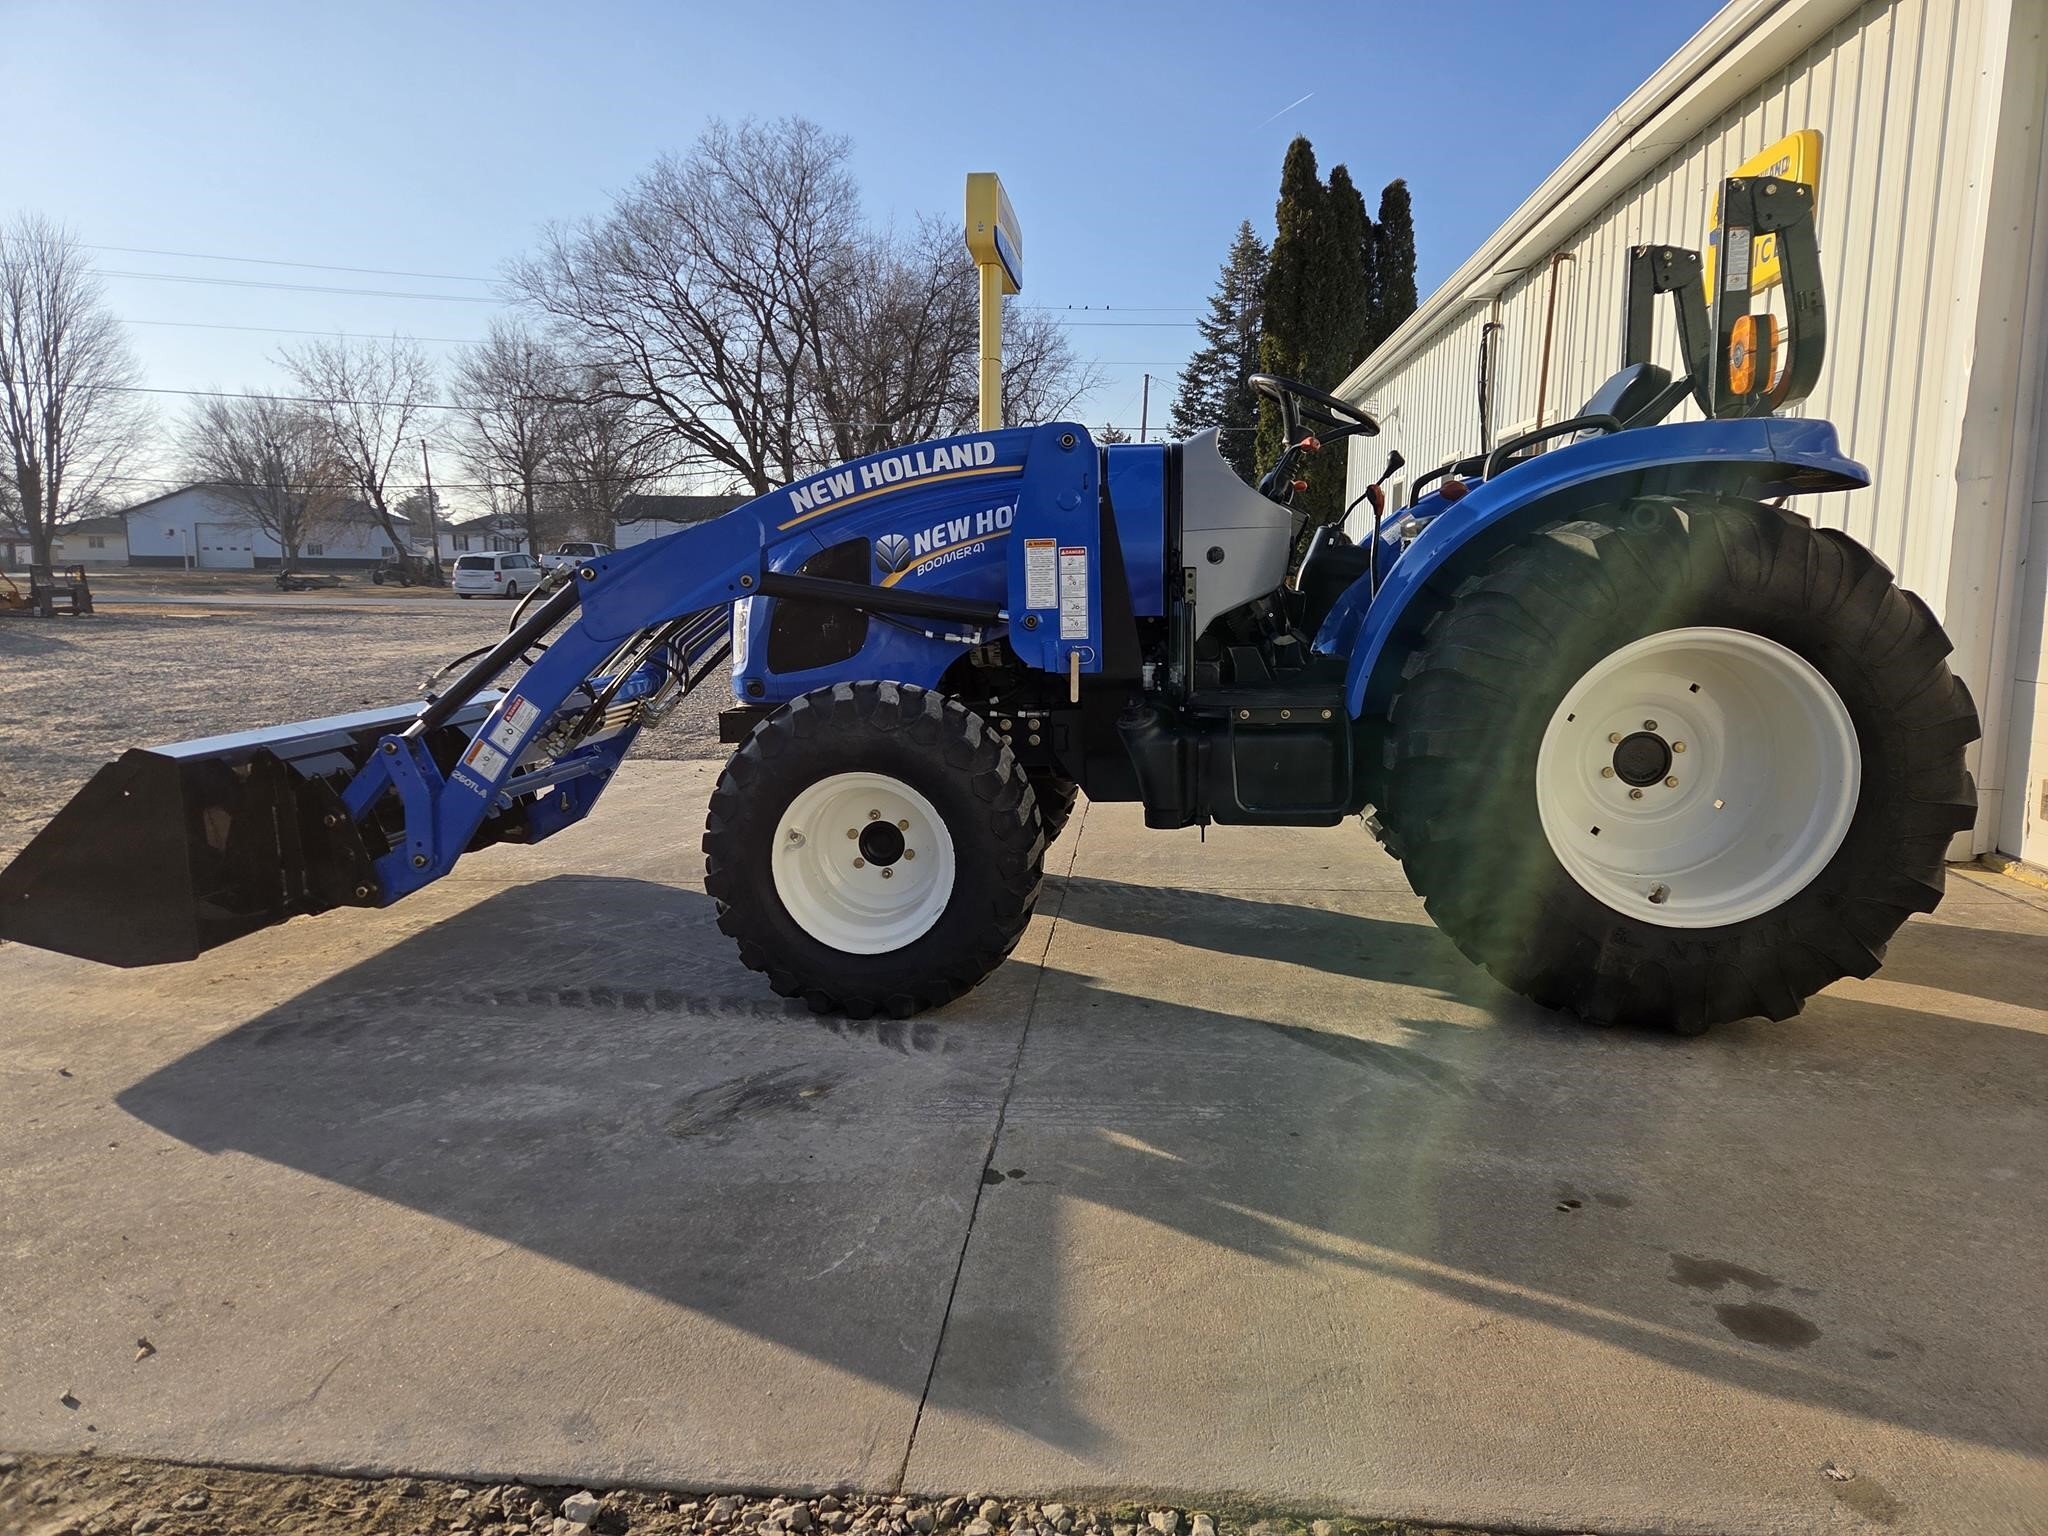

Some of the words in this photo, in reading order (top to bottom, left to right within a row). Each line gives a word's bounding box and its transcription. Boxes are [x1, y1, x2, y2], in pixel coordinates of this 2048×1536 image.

[788, 470, 855, 514] NEW
[859, 441, 996, 489] HOLLAND
[914, 515, 971, 556] NEW
[917, 547, 972, 576] BOOMER
[973, 542, 985, 553] 41
[451, 769, 488, 799] 260TLA
